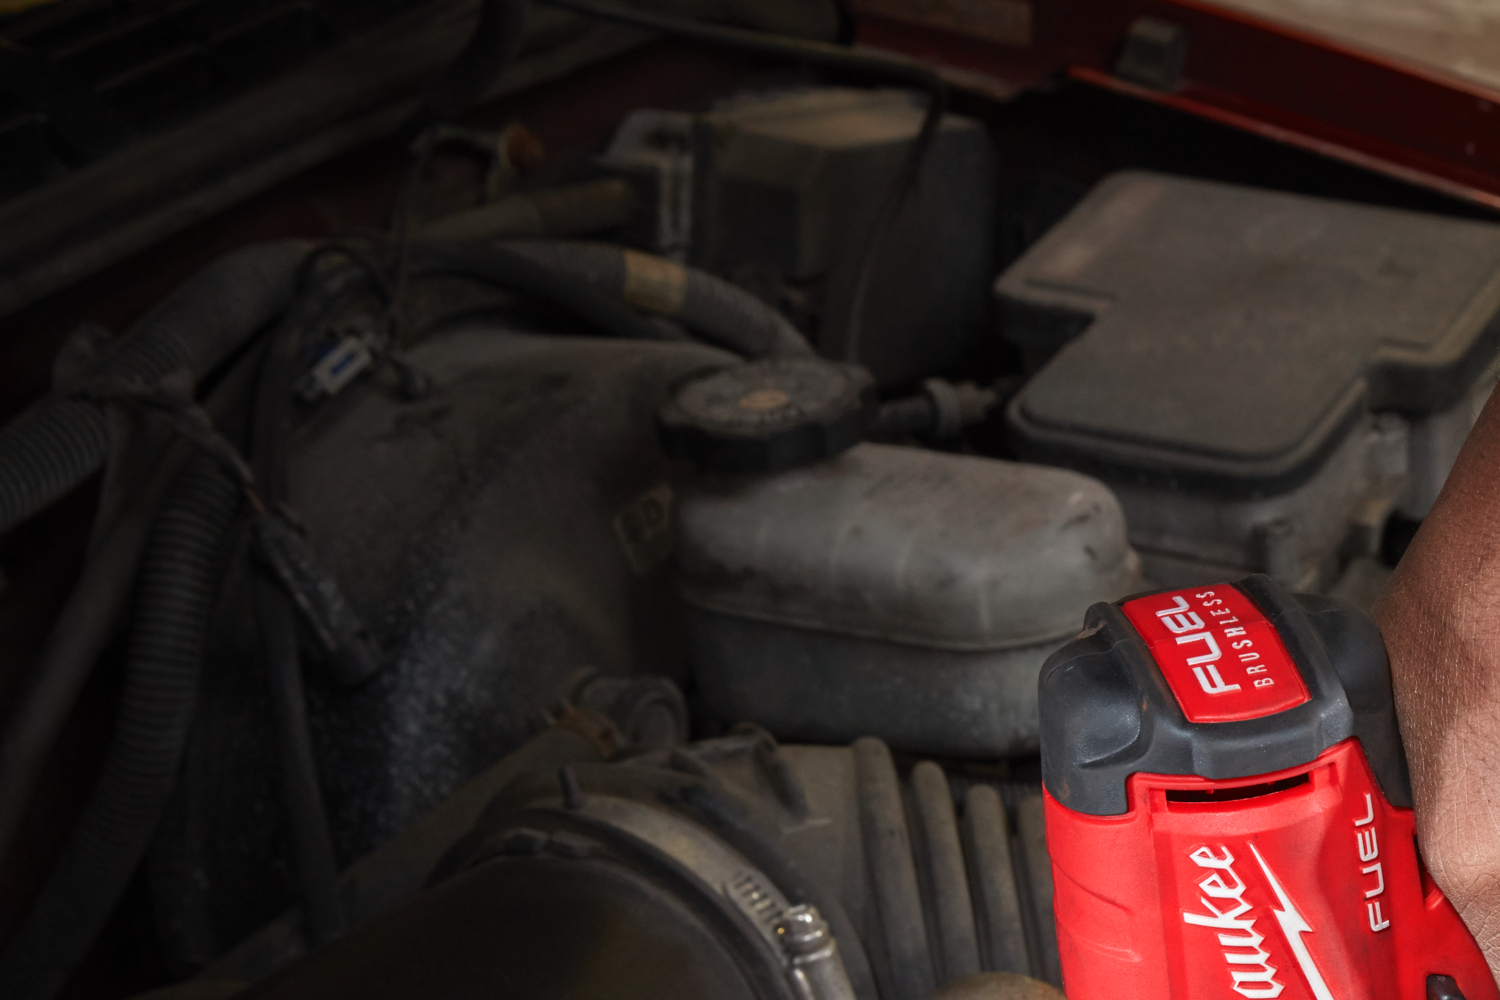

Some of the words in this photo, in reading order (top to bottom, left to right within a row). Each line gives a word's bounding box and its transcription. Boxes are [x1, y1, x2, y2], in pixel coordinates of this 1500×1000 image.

[1155, 595, 1242, 695] FUEL
[1195, 590, 1275, 688] BRUSHLESS
[1354, 792, 1391, 932] FUEL
